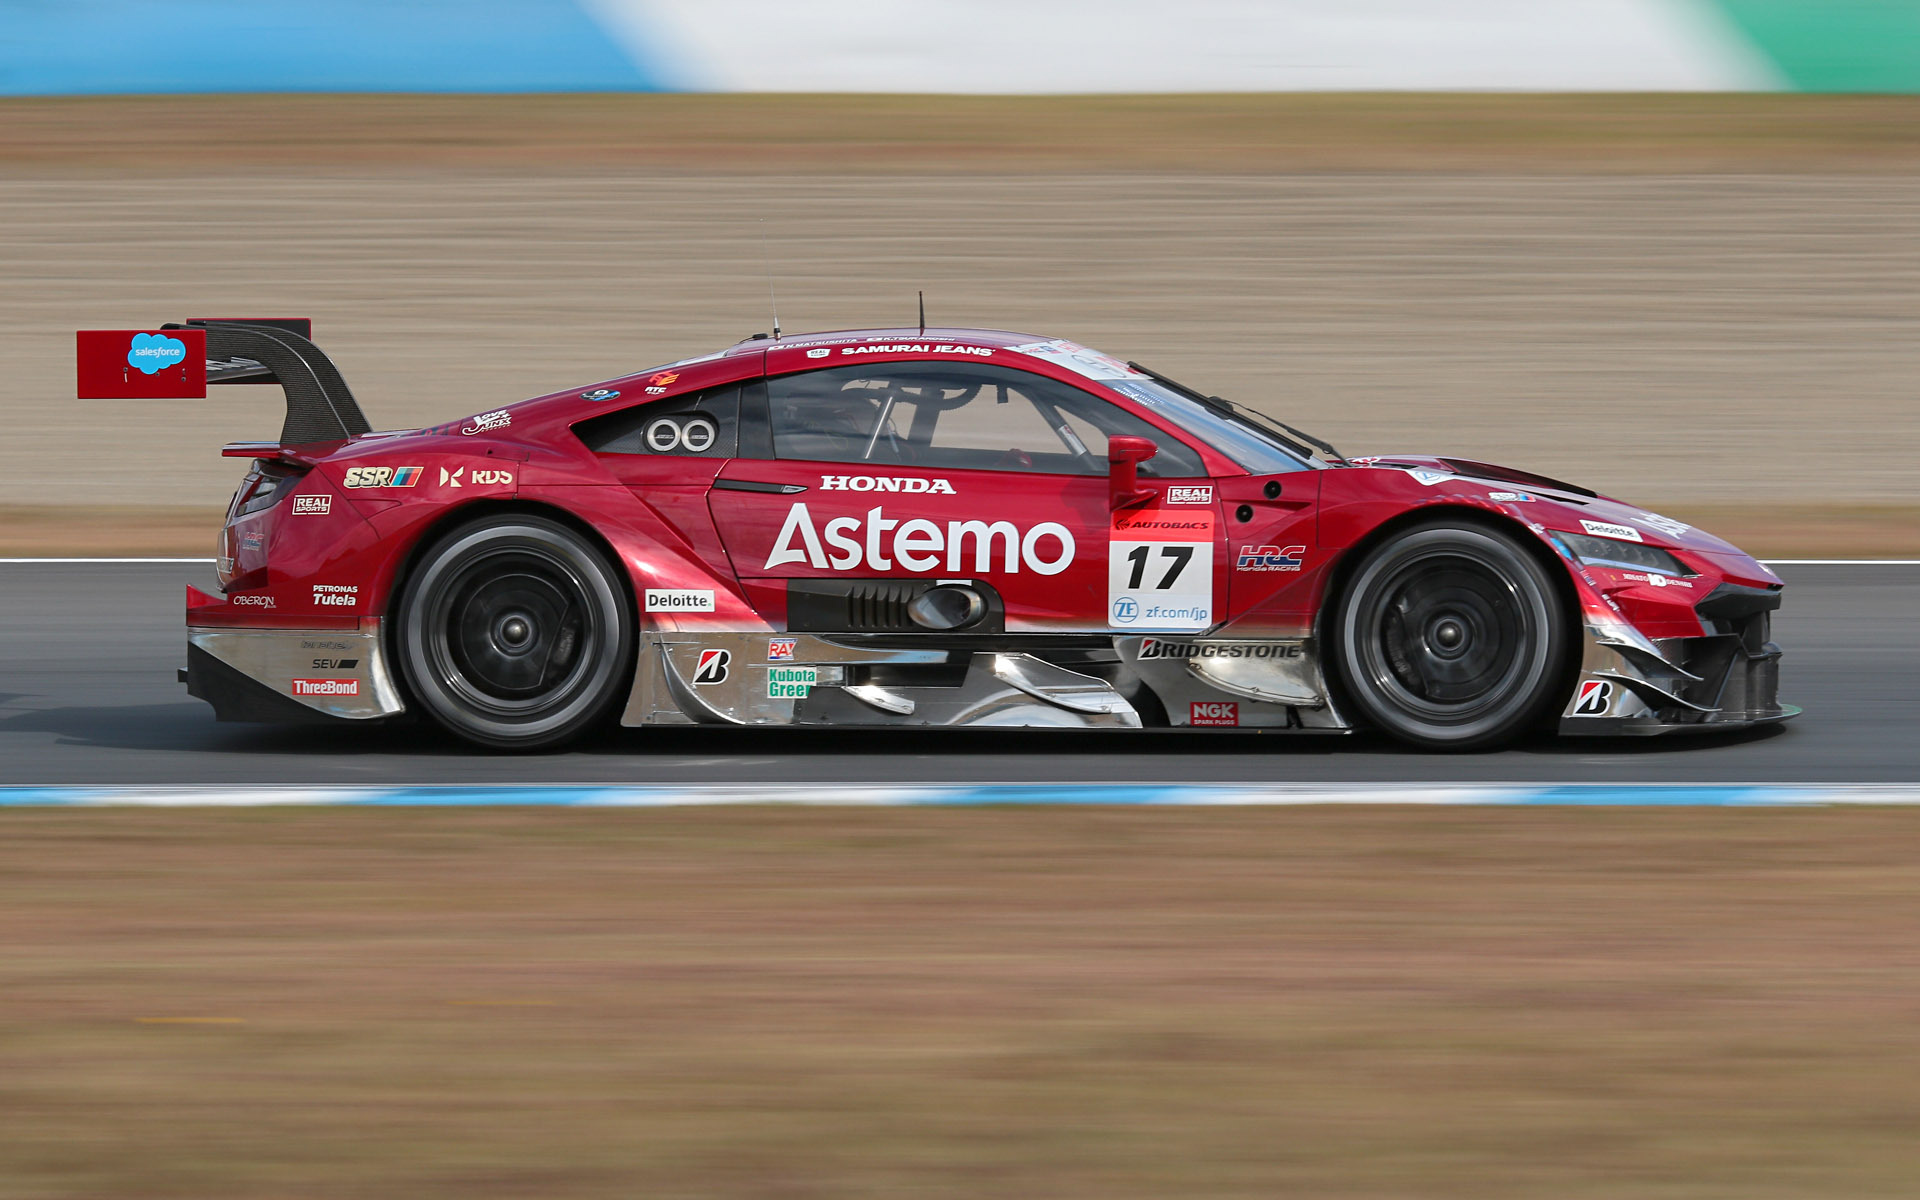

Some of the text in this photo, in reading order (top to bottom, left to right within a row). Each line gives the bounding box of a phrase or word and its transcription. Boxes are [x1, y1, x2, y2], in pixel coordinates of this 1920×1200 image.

[135, 347, 180, 358] salesforce
[841, 344, 930, 355] SAMURAI
[343, 467, 393, 488] SSR
[472, 470, 513, 484] RDS
[819, 475, 957, 494] HONDA
[1171, 489, 1210, 497] REAL
[297, 498, 329, 506] REAL
[1130, 521, 1209, 530] AUTOBACS
[763, 502, 1076, 575] Astemo
[1237, 545, 1306, 567] HRC
[1128, 545, 1194, 589] 17
[233, 595, 274, 609] OBERON
[313, 594, 356, 606] Tutela
[1146, 606, 1208, 621] zf.com/jp
[1137, 638, 1302, 660] BRIDGESTONE
[312, 659, 338, 668] SEV
[769, 668, 815, 682] Kubota
[293, 680, 358, 694] ThreeBond
[1194, 703, 1235, 718] NGK
